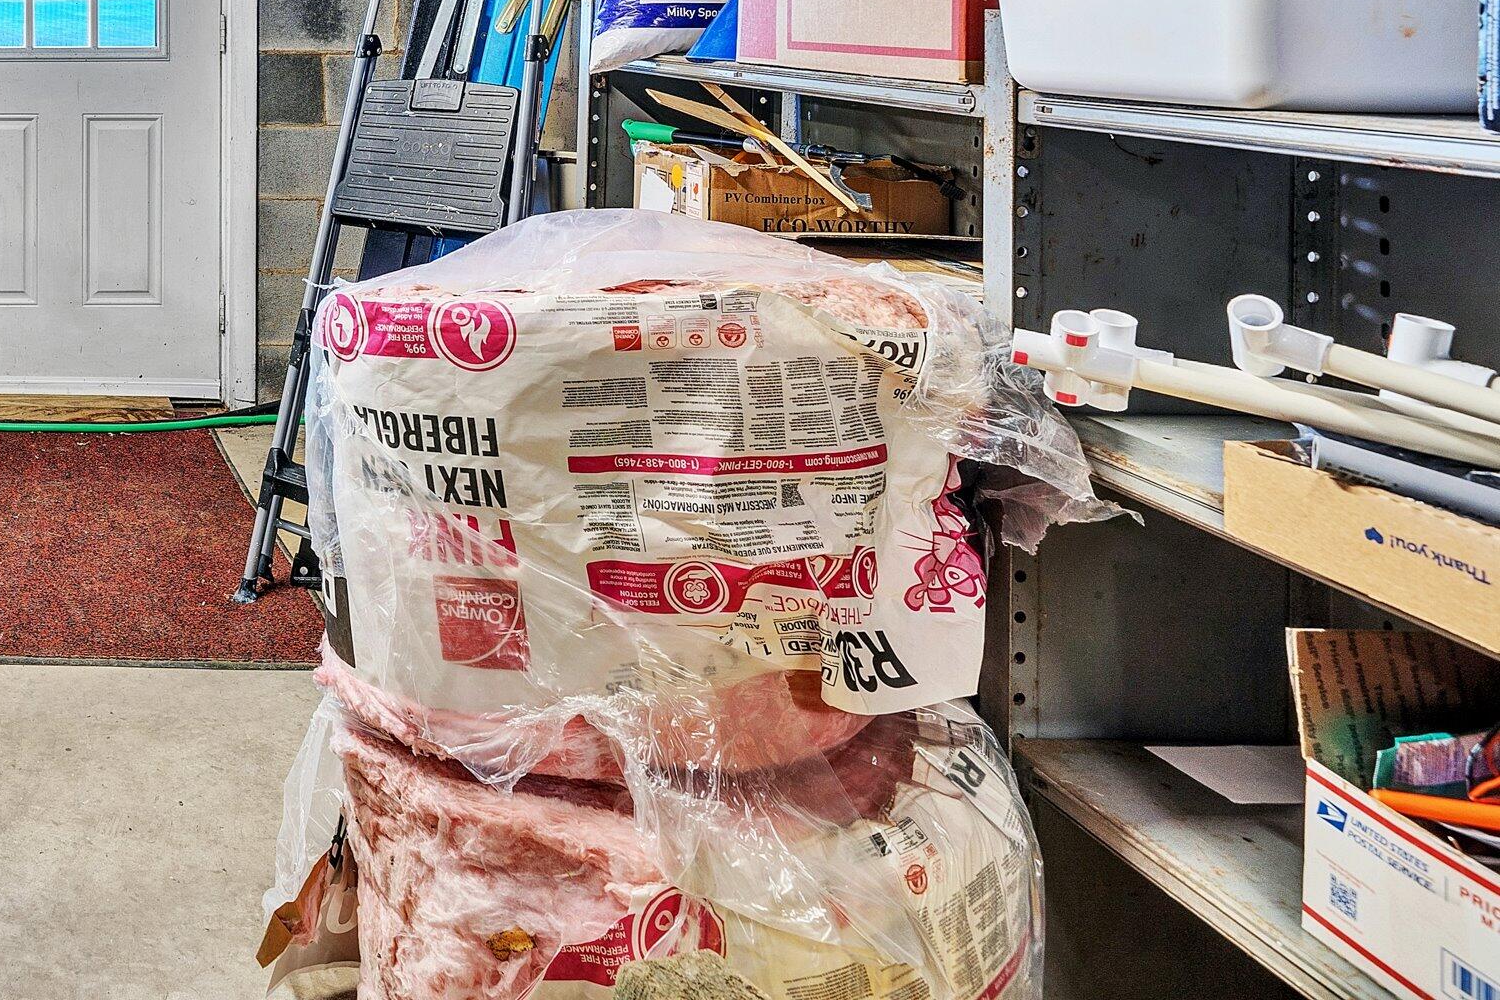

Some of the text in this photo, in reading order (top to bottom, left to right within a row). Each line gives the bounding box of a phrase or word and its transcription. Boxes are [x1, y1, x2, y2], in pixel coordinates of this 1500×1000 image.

[666, 7, 696, 21] Milky
[724, 192, 826, 205] PV Combiner box
[762, 217, 916, 234] ECO-WORTHY
[387, 333, 425, 342] SAFER FIRE
[404, 343, 427, 354] 99%
[614, 456, 701, 471] (1-800-438-7465)
[424, 463, 508, 509] NEXT
[830, 493, 858, 504] INFO?
[642, 496, 777, 516] ¿NECESITA MÁS INFORMACIÓN?
[733, 549, 757, 558] PUEDE
[756, 547, 772, 557] QUE
[771, 542, 825, 554] HERRAMIENTAS
[1389, 534, 1491, 586] Thank you!
[776, 570, 802, 579] FASTER
[619, 590, 648, 598] COTTON
[639, 599, 660, 607] FEELS
[439, 602, 504, 625] OWENS
[734, 622, 760, 630] Attics
[779, 620, 819, 632] RDADOR
[786, 640, 820, 653] CED
[1350, 816, 1429, 873] UNITED STATES
[1346, 830, 1435, 890] POSTAL SERVICE
[580, 954, 602, 964] FIRE
